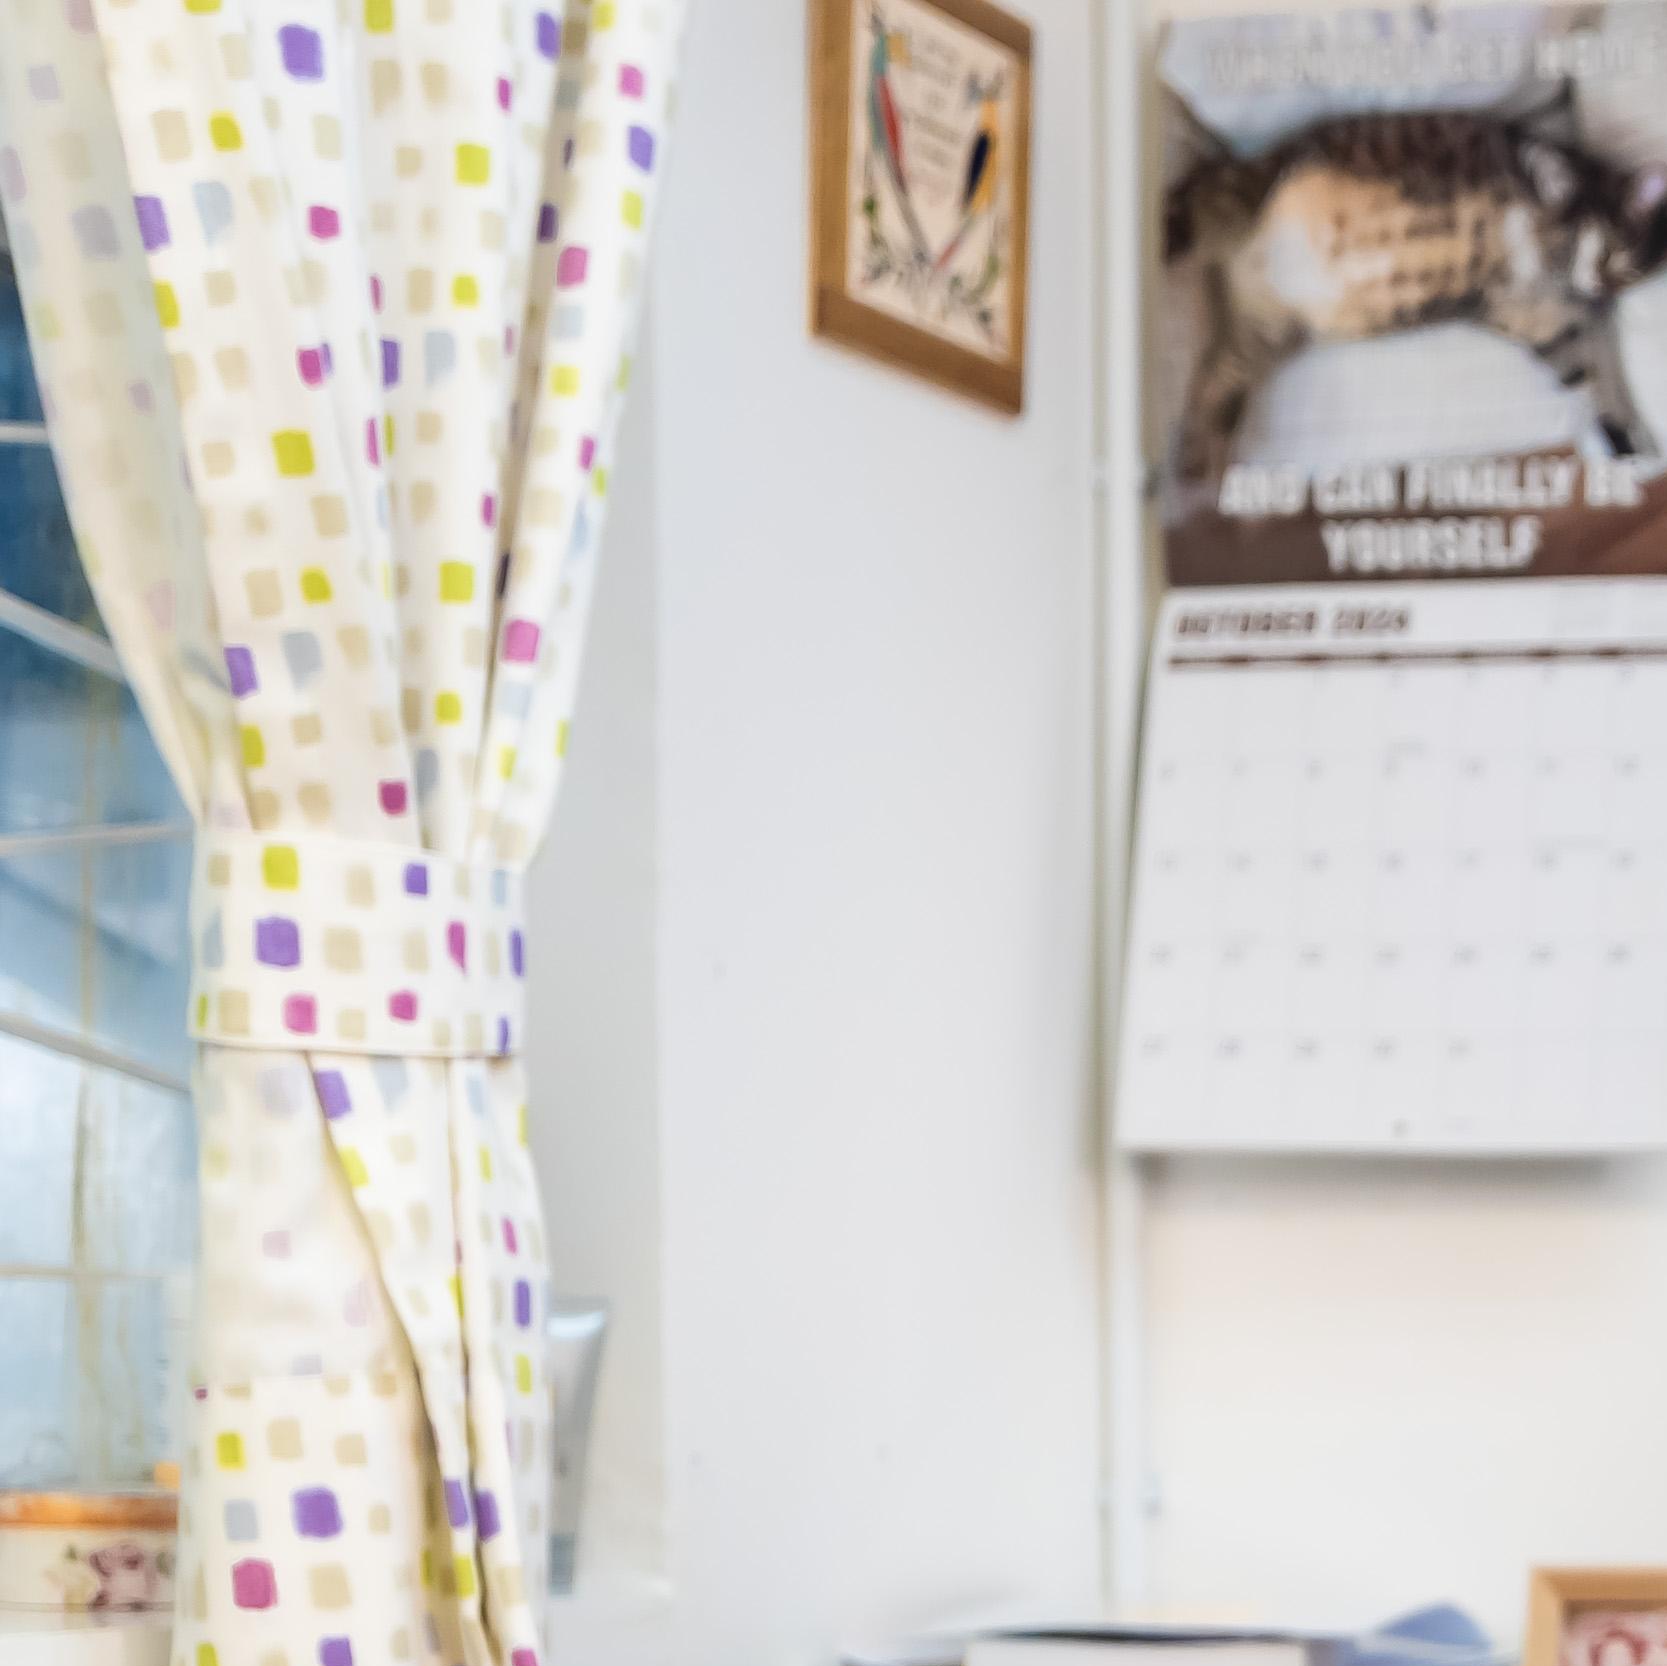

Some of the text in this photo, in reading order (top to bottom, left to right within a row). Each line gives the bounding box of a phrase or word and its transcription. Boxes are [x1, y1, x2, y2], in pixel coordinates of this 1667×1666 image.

[1217, 456, 1645, 516] AND CAN FINALLY BE
[1320, 515, 1545, 574] YOURSELF
